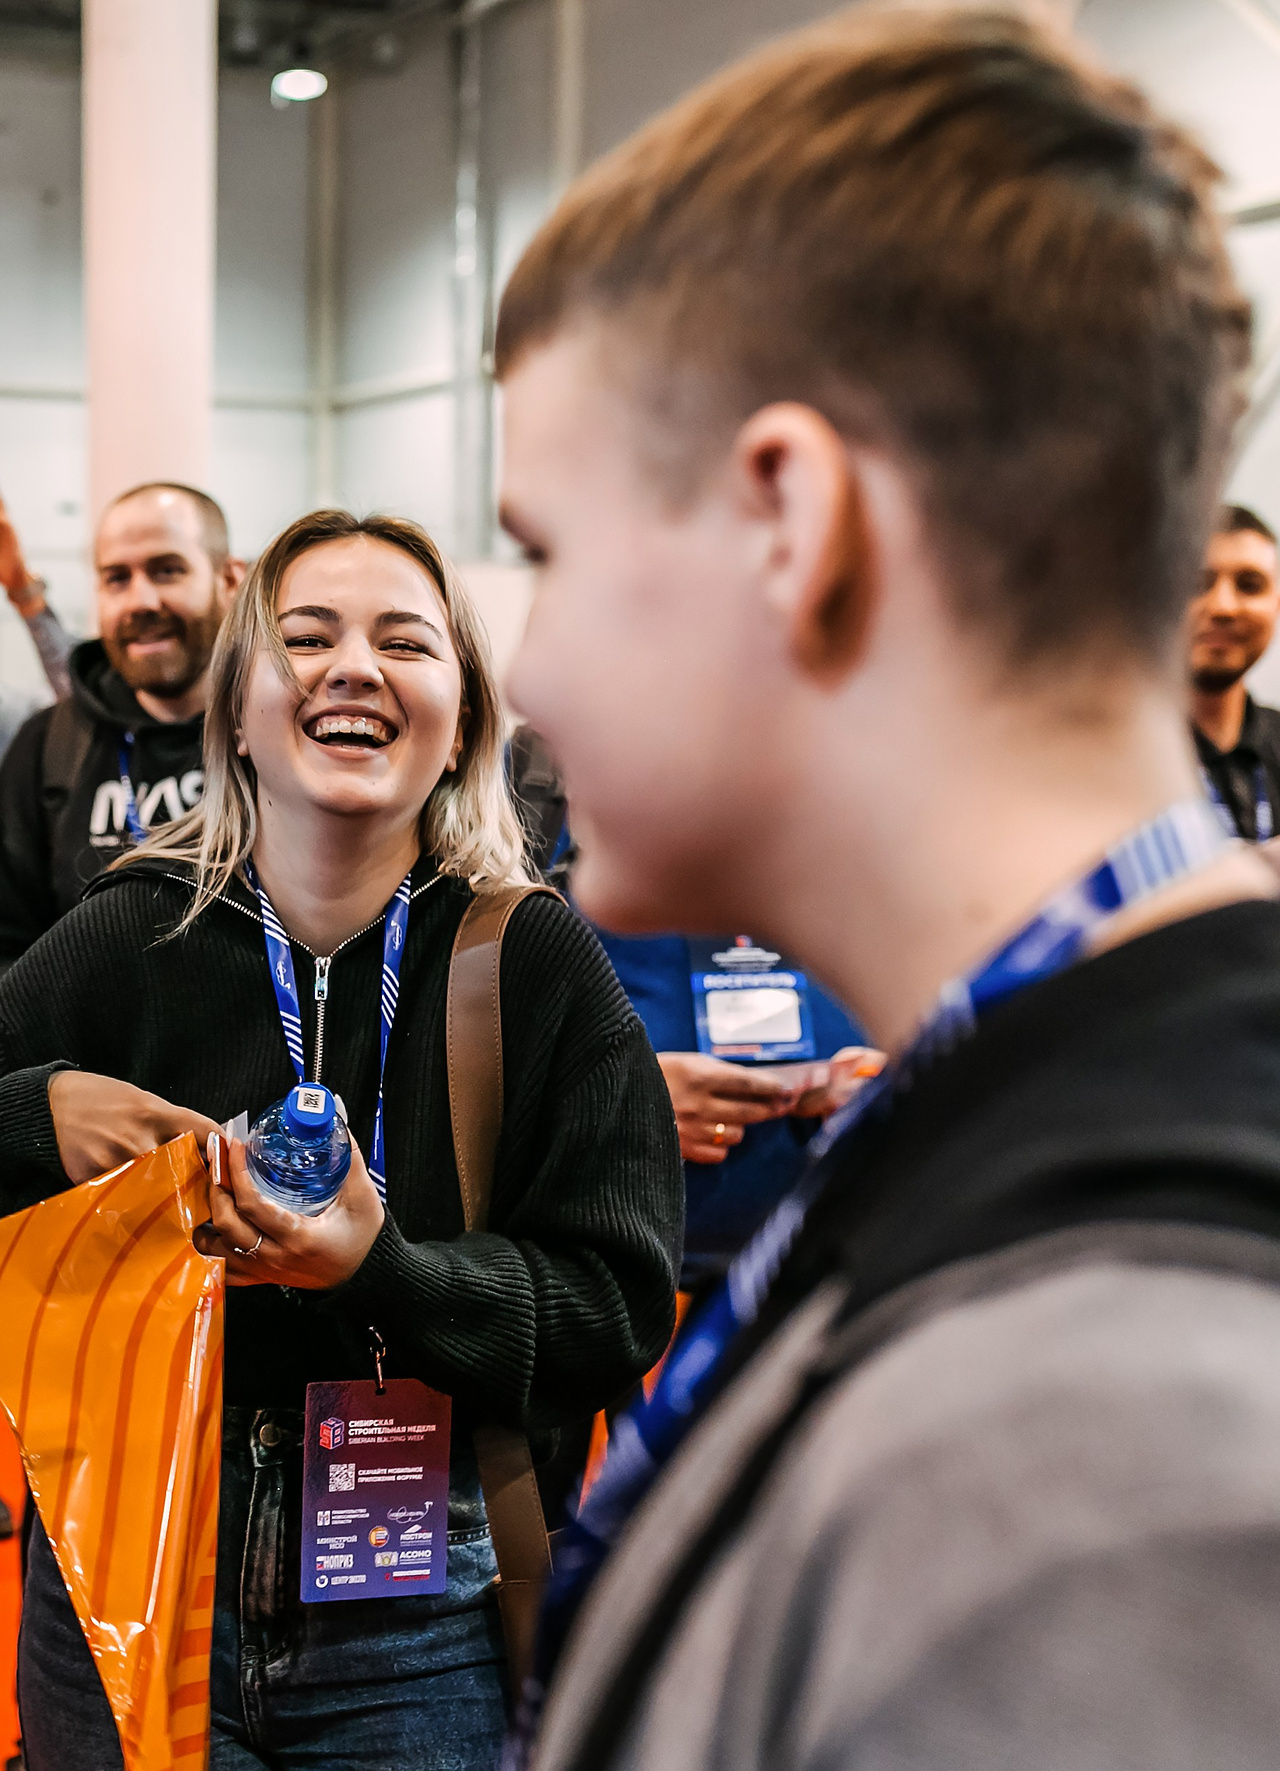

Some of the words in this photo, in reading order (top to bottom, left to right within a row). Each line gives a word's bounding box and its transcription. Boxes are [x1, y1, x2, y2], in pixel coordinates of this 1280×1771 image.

[348, 1419, 394, 1428] СИБИРСКАЯ
[348, 1426, 407, 1436] СТРОИТЕЛЬНАЯ
[407, 1424, 437, 1433] НЕДЕЛЯ
[348, 1437, 376, 1445] SIBERIAN
[400, 1549, 432, 1559] АСОНО
